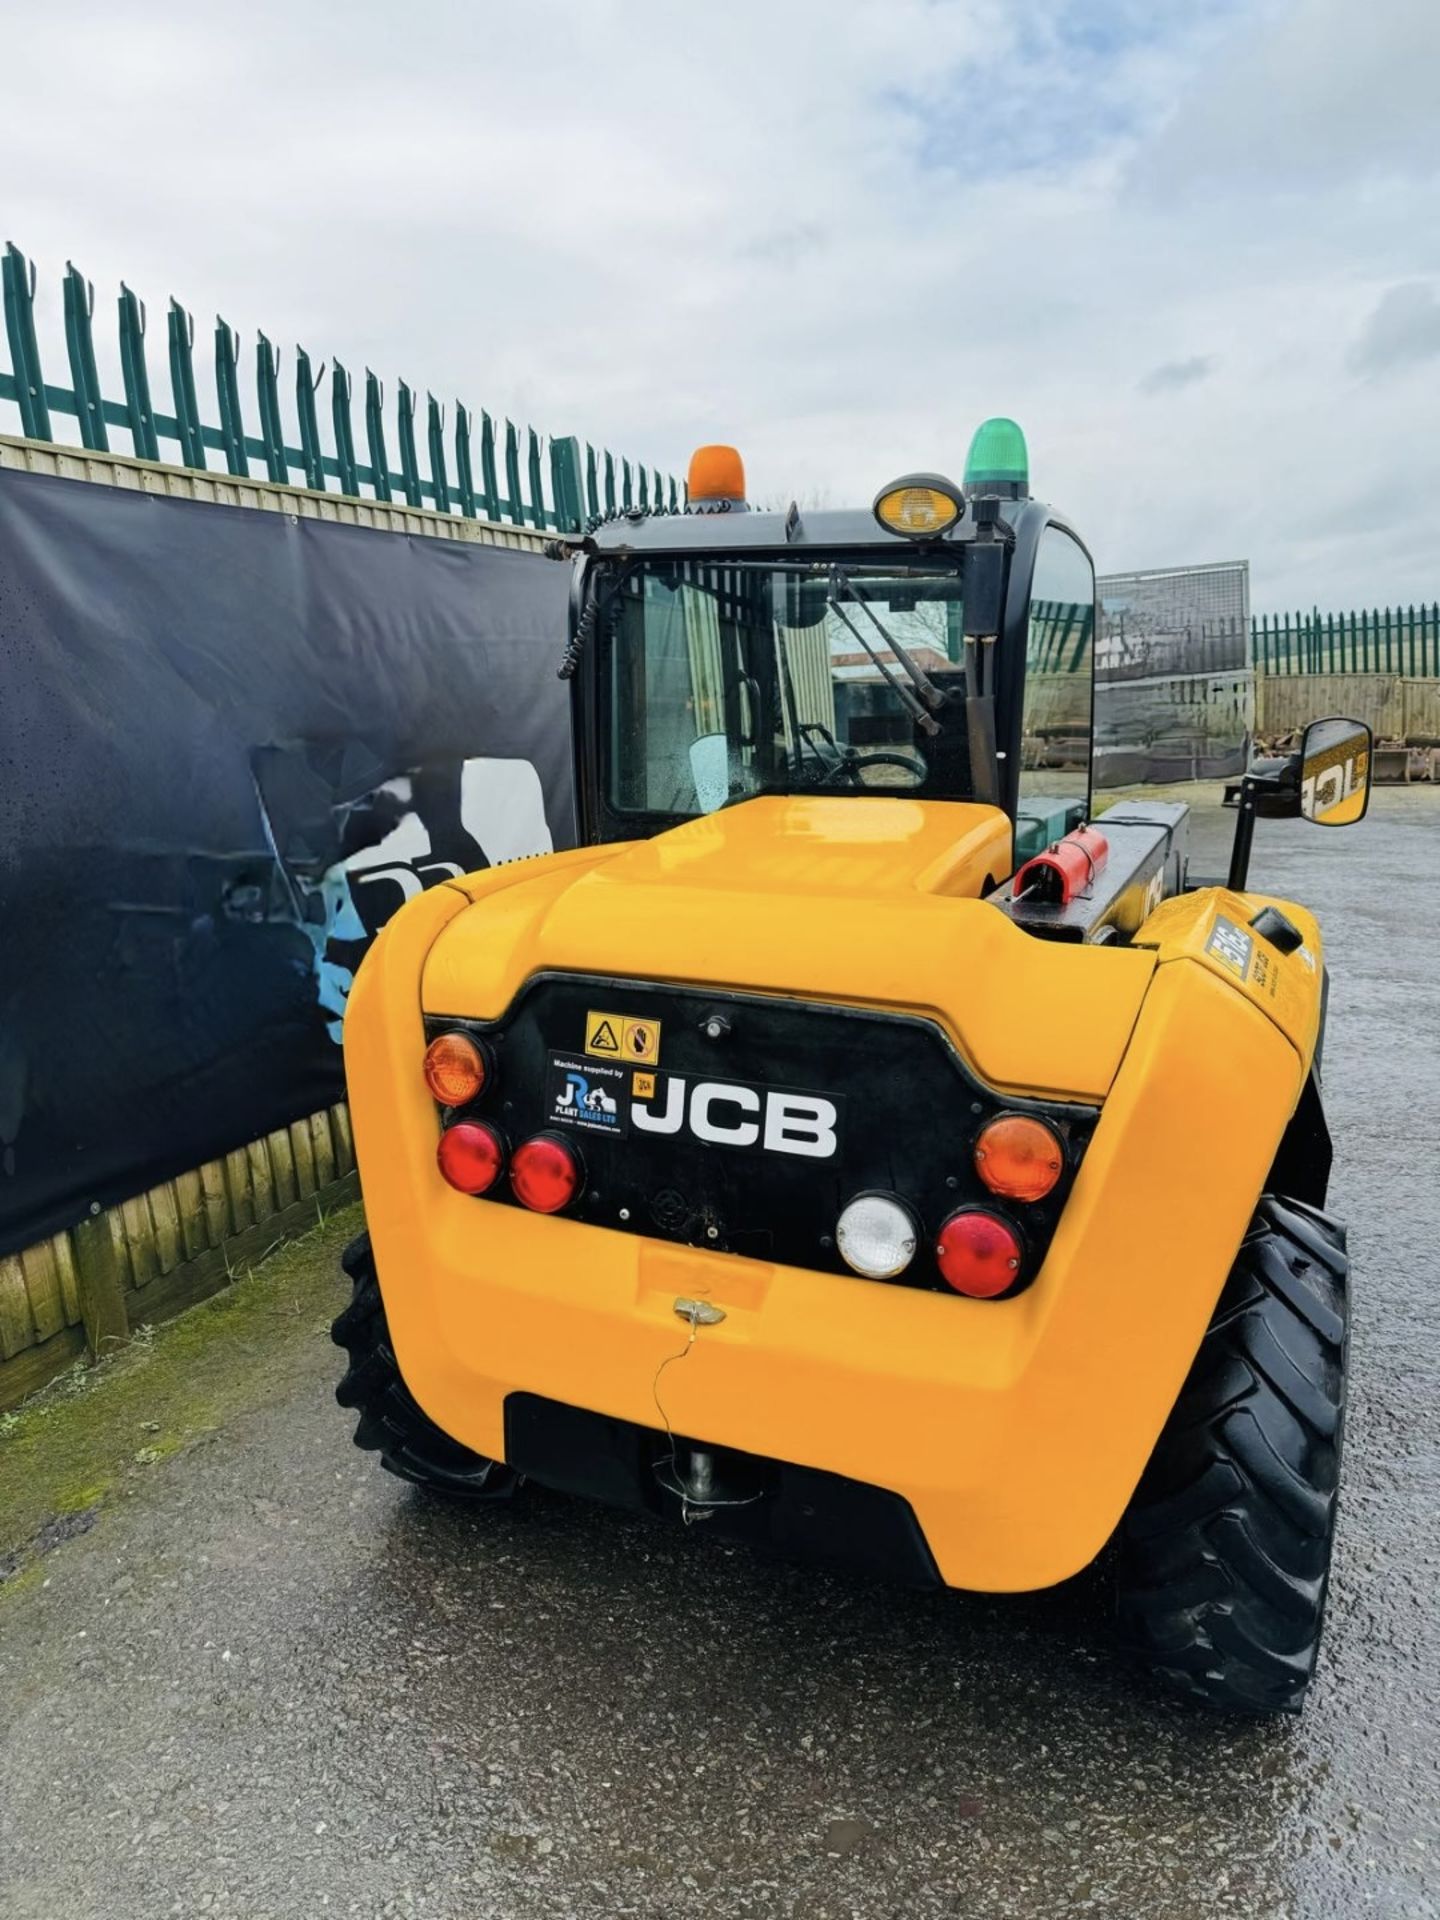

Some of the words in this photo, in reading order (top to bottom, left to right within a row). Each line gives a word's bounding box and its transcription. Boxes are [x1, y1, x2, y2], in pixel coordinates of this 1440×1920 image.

[554, 1059, 582, 1071] Machine
[583, 1064, 613, 1075] supplied
[614, 1070, 623, 1078] by
[555, 1106, 578, 1117] PLANT
[579, 1109, 601, 1121] SALES
[602, 1113, 617, 1124] LTD
[631, 1077, 837, 1158] JCB
